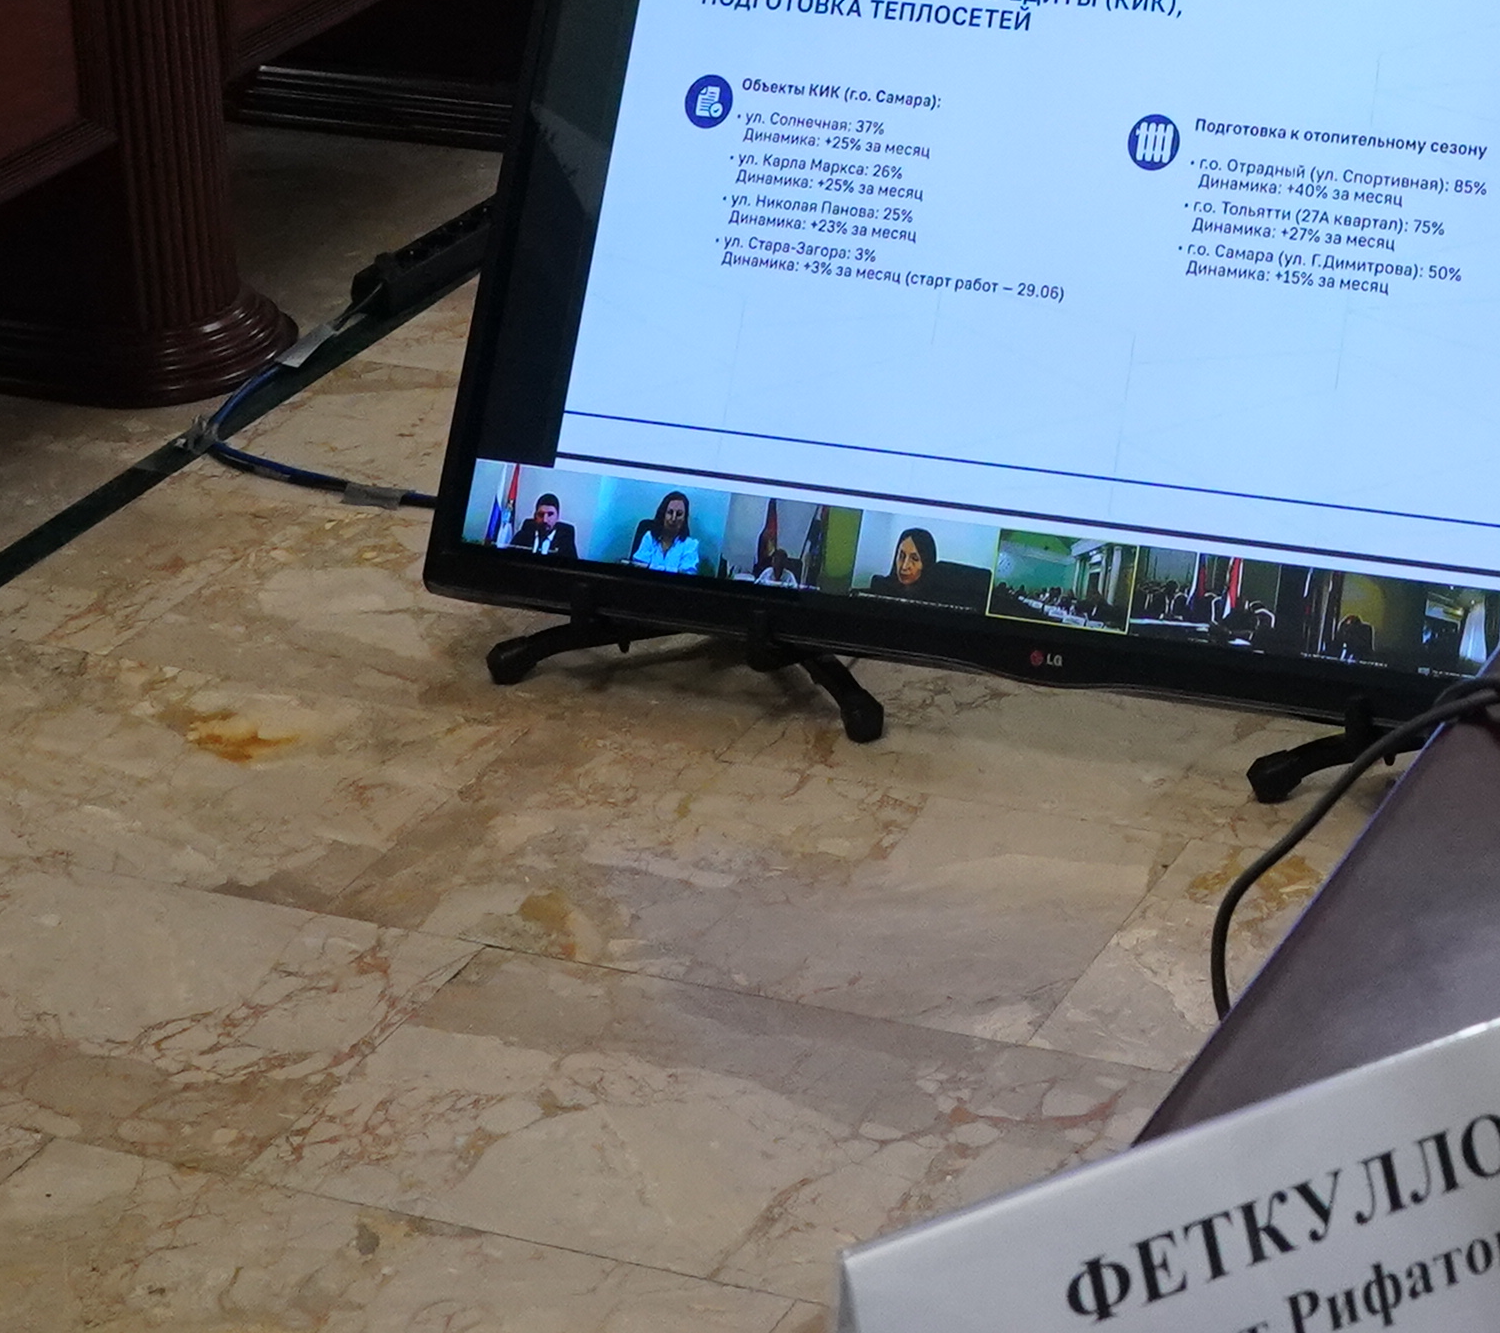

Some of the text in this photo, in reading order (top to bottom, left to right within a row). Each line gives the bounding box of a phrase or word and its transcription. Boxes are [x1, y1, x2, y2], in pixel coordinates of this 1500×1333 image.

[870, 0, 1032, 32] ТЕПЛОСЕТЕЙ
[742, 77, 941, 111] Объекты КИК (г.о. Самара):
[745, 111, 885, 135] ул. Солнечная: 37%
[1195, 118, 1488, 160] Подготовка к отопительному сезону
[742, 127, 930, 160] Динамика: +25% за месяц
[738, 153, 903, 180] ул. Карла Маркса: 26%
[1199, 158, 1487, 196] г.о. Отрадный (ул. Спортивная): 85%
[735, 168, 923, 202] Динамика: +25% за месяц
[1197, 173, 1403, 208] Динамика: +40% за месяц
[731, 194, 913, 224] ул. Николая Панова: 25%
[1193, 201, 1216, 214] г.о.
[1222, 200, 1291, 221] Тольятти
[1333, 214, 1409, 235] квартал):
[1414, 219, 1445, 236] 75%
[728, 210, 917, 244] Динамика: +23% за месяц
[1191, 217, 1395, 252] Динамика: +27% за месяц
[723, 236, 876, 263] ул. Стара-Загора: 3%
[1187, 244, 1210, 256] г.о.
[1215, 244, 1274, 265] Самара
[1278, 250, 1306, 268] (ул.
[1428, 265, 1462, 282] 50%
[720, 250, 800, 272] Динамика:
[803, 260, 833, 276] +3%
[835, 265, 852, 278] за
[855, 268, 901, 285] месяц
[905, 270, 952, 290] (старт
[954, 277, 999, 293] работ
[1017, 282, 1065, 304] 29.06)
[1185, 260, 1389, 296] Динамика: +15% за месяц
[1046, 653, 1063, 667] LG
